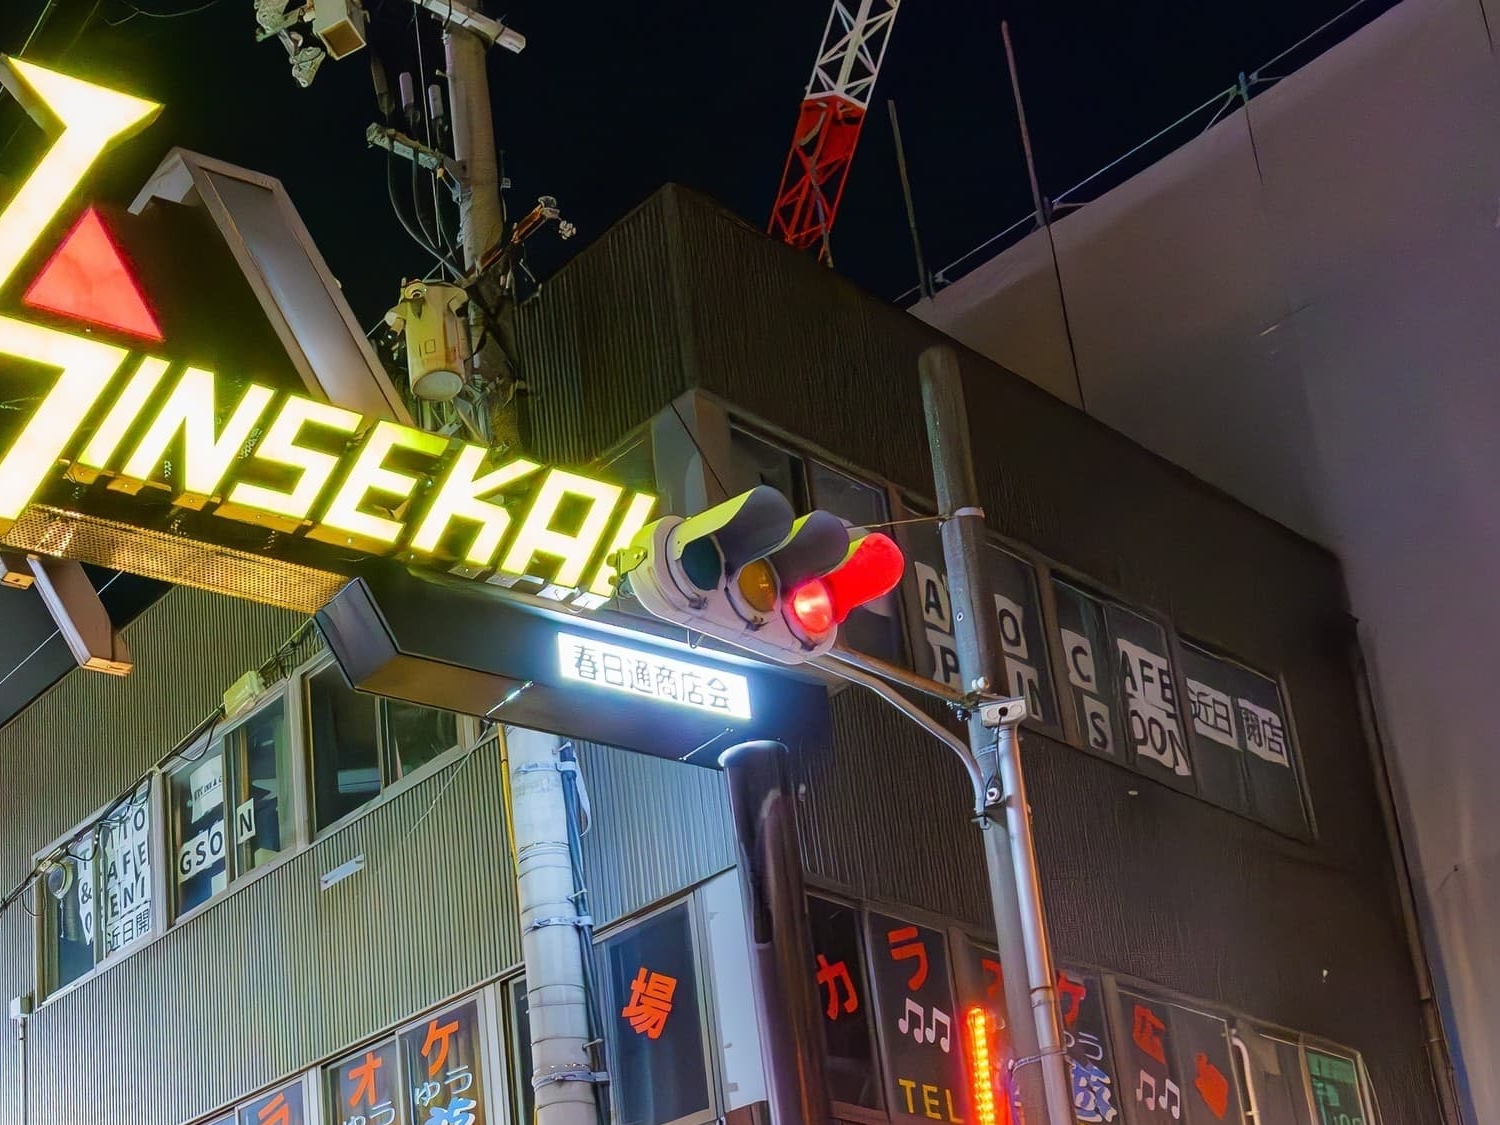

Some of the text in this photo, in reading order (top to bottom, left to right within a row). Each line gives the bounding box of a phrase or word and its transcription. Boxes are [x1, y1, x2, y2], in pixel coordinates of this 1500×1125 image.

[573, 645, 732, 713] 春日通商店会
